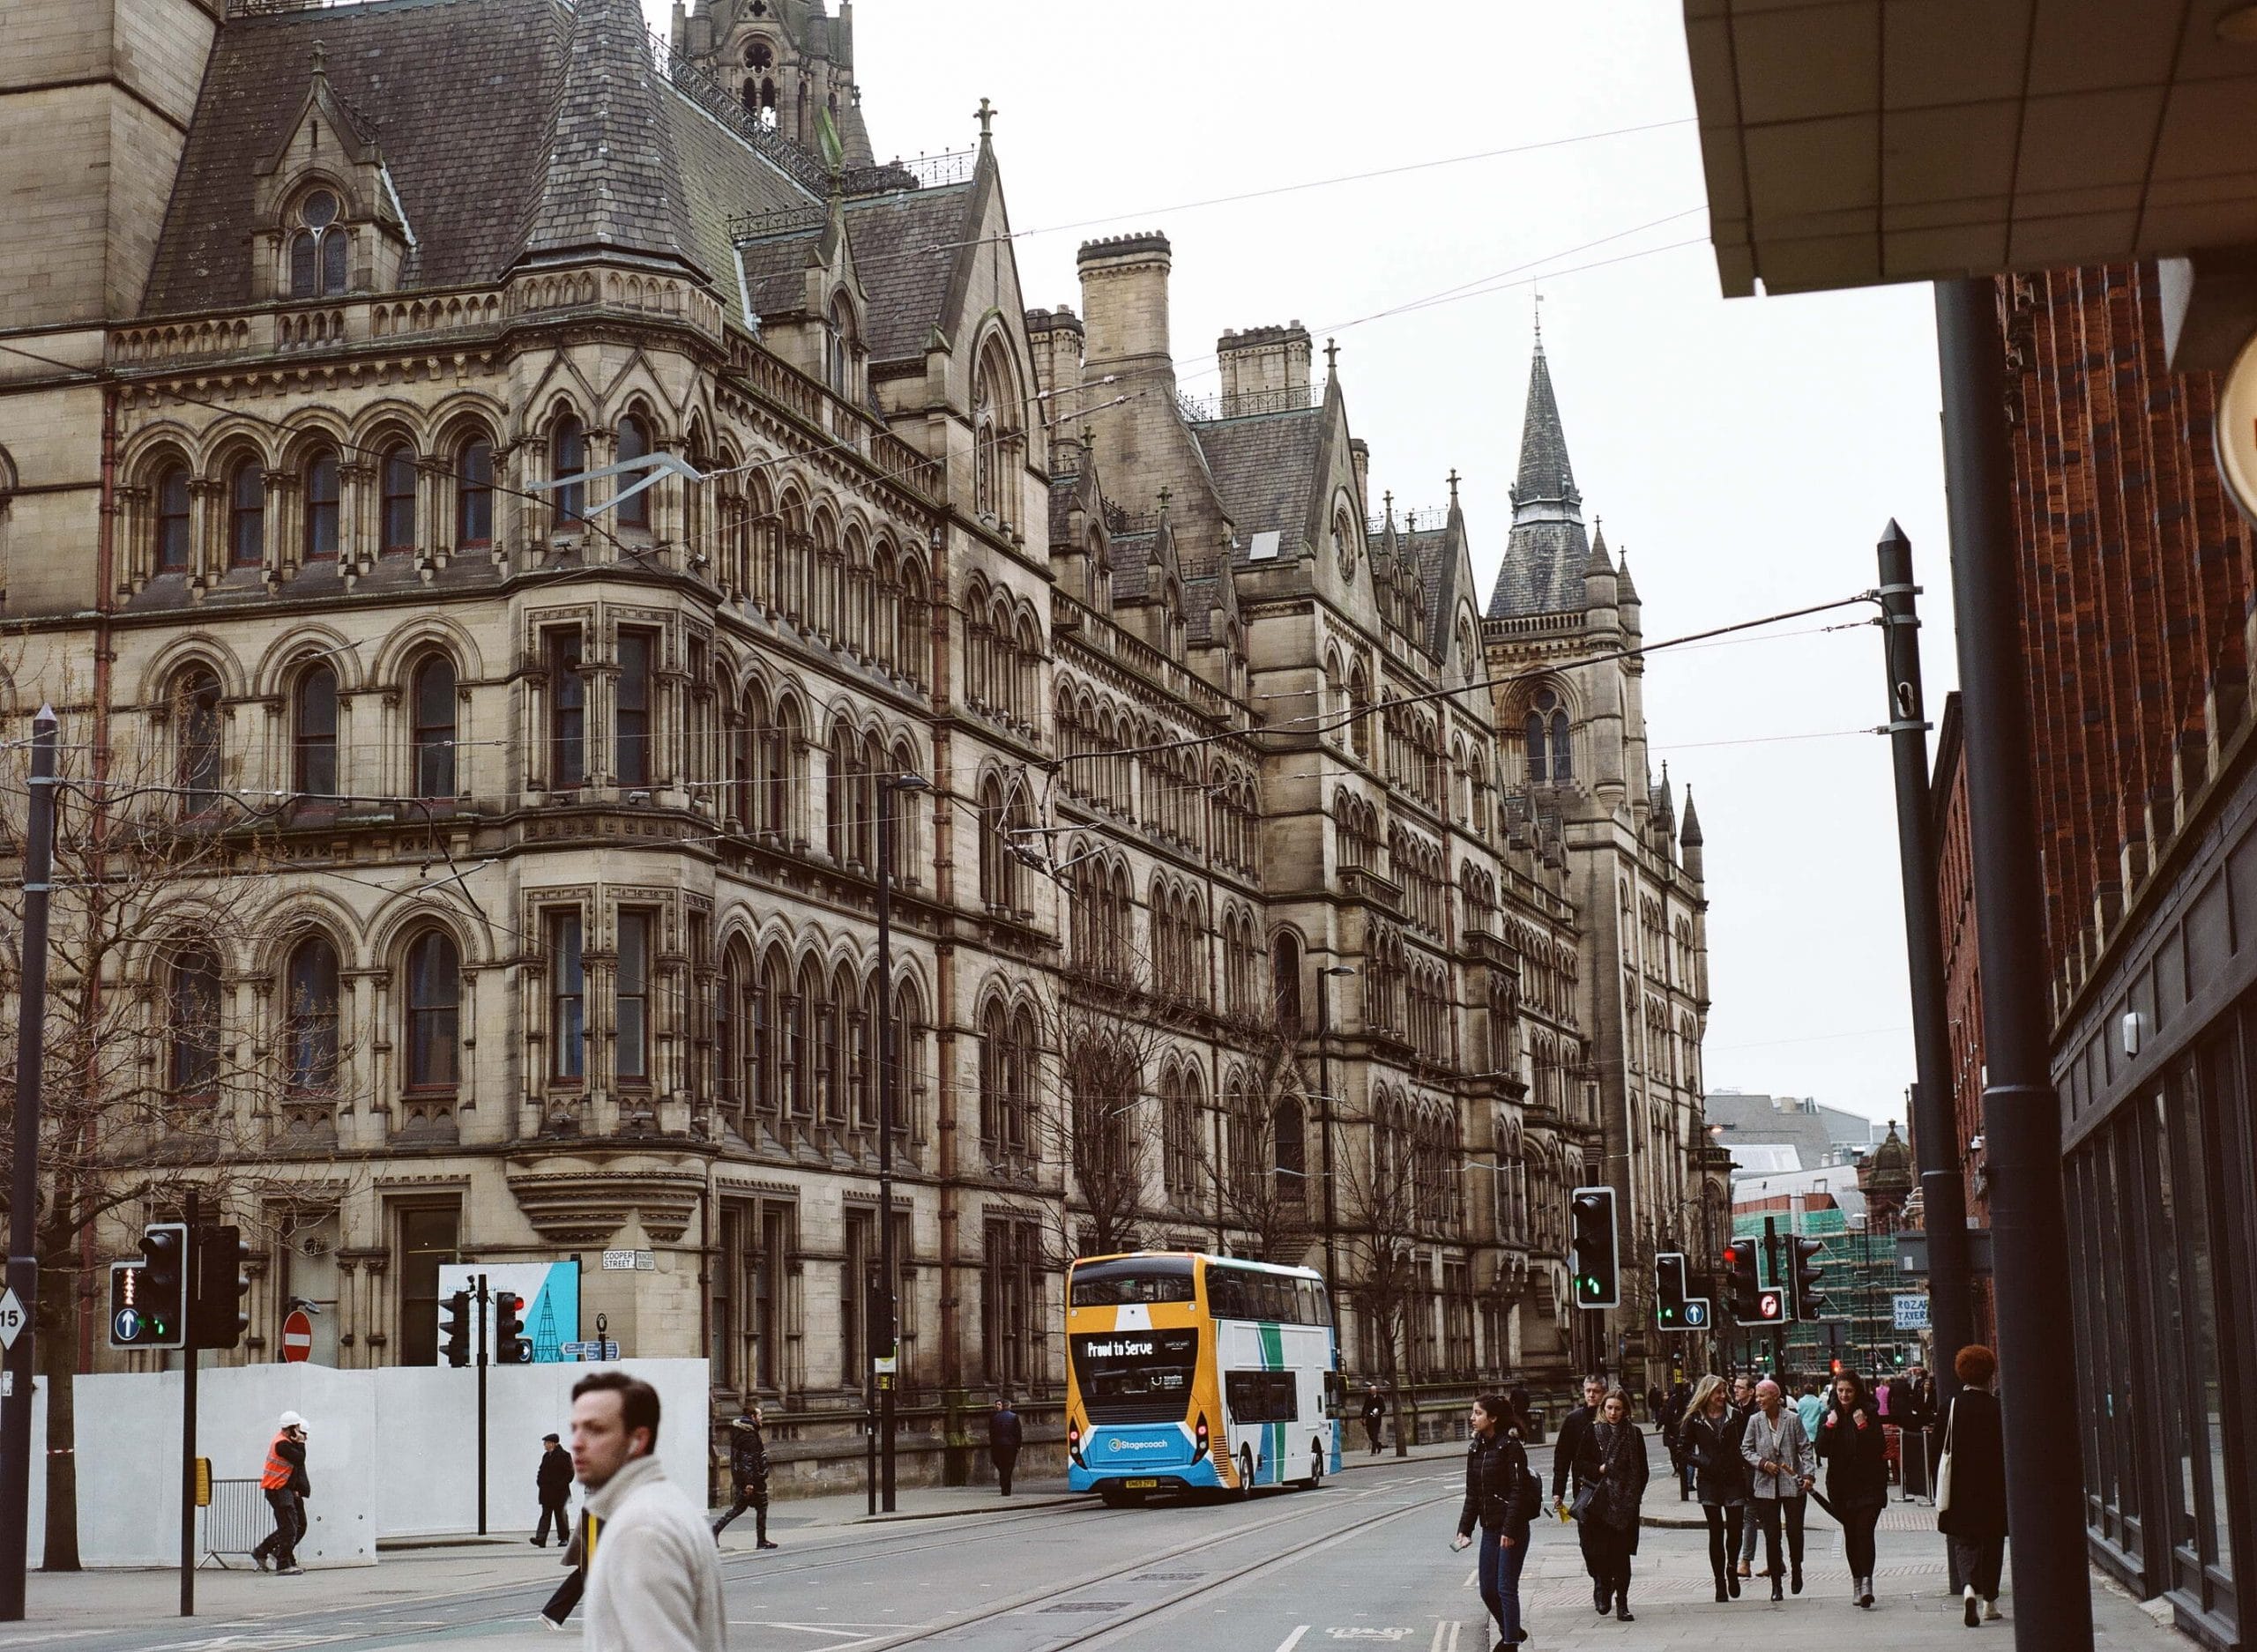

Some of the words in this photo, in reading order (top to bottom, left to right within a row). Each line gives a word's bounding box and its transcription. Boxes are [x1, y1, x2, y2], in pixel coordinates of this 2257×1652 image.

[0, 1310, 18, 1327] 15
[1087, 1341, 1112, 1358] Proud
[1114, 1341, 1123, 1356] to
[1125, 1340, 1153, 1356] Serve
[1121, 1439, 1168, 1450] Stagecoach
